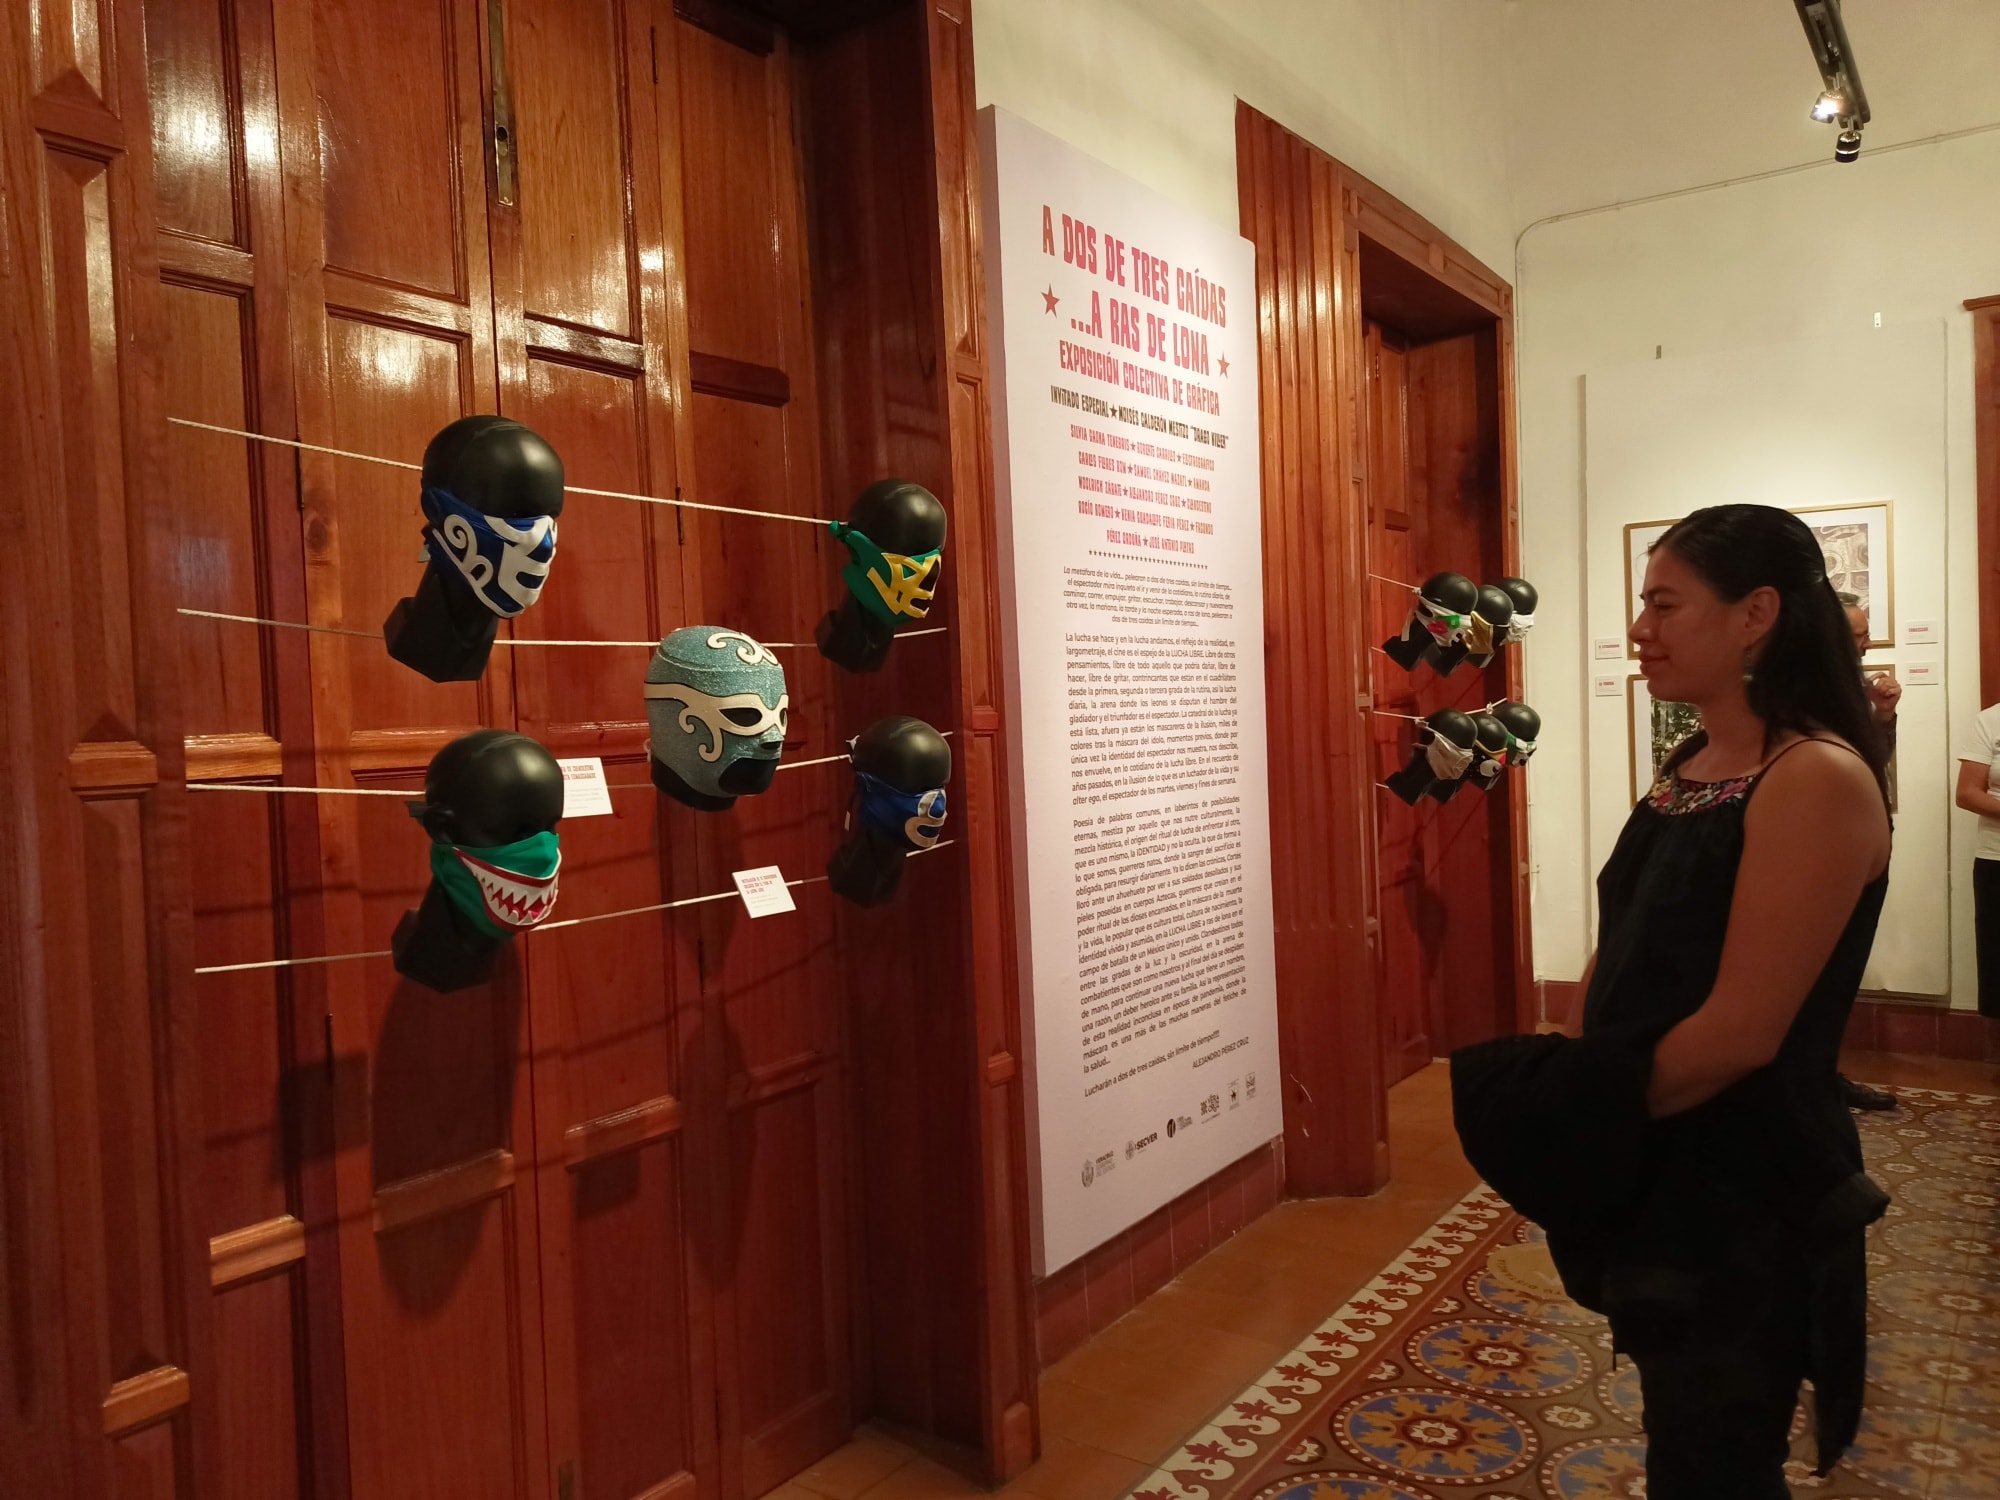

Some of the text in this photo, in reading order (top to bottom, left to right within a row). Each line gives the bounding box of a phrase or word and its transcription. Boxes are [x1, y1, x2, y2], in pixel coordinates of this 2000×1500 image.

[1043, 205, 1226, 328] A DOS DE TRES CAÍDAS
[1110, 298, 1140, 352] RAS
[1147, 313, 1166, 362] DE
[1173, 323, 1209, 376] LONA
[1060, 340, 1220, 416] EXPOSICIÓN COLECTIVA DE GRÁFICA
[1141, 412, 1167, 433] CALDERÓN
[1074, 633, 1091, 642] lucha
[1089, 673, 1102, 682] libre
[1068, 688, 1087, 696] desde
[1069, 714, 1098, 725] gladiador
[1071, 741, 1092, 750] colores
[1073, 796, 1087, 805] alter
[1075, 844, 1096, 855] mezcla
[1075, 861, 1087, 871] que
[1096, 857, 1108, 865] uno
[1083, 873, 1095, 882] que
[1104, 881, 1117, 891] para
[1092, 897, 1105, 906] ante
[1077, 913, 1095, 926] pieles
[1078, 927, 1095, 939] poder
[1097, 920, 1111, 932] ritual
[1079, 948, 1106, 964] identidad
[1079, 966, 1100, 978] campo
[1080, 976, 1108, 991] entre las
[1081, 986, 1120, 1005] combatientes
[1111, 998, 1123, 1010] para
[1082, 1023, 1093, 1032] una
[1093, 1032, 1105, 1042] esta
[1118, 1072, 1128, 1081] dos
[1137, 1063, 1148, 1072] tres
[1167, 1050, 1175, 1060] sin
[1136, 1132, 1158, 1150] SECVER
